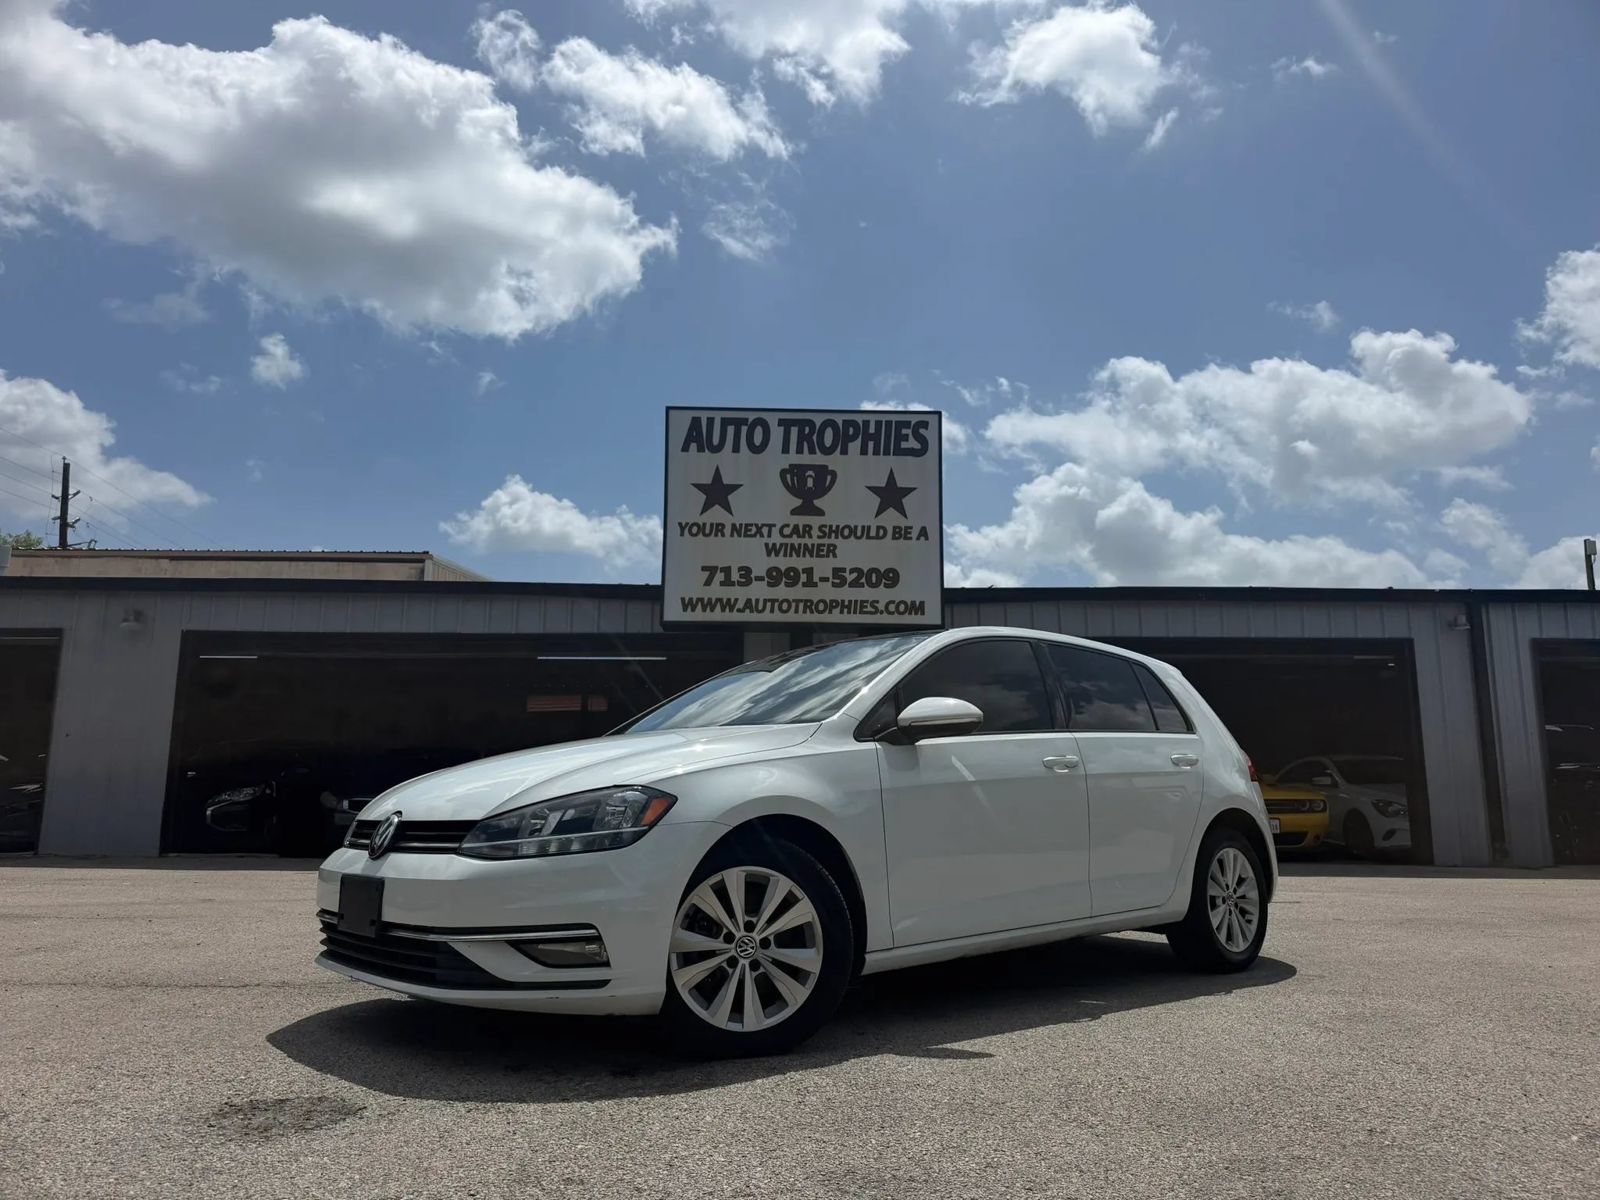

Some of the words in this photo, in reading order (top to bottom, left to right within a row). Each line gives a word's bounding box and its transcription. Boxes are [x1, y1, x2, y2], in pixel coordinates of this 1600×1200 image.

[680, 416, 771, 454] AUTO
[777, 418, 930, 458] TROPHIES
[677, 522, 726, 538] YOUR
[730, 523, 776, 538] NEXT
[779, 523, 814, 539] CAR
[817, 524, 888, 541] SHOULD
[891, 525, 913, 541] BE
[916, 526, 929, 541] A
[764, 542, 838, 558] WINNER
[701, 565, 900, 589] 713-991-5209
[680, 597, 926, 616] WWW.AUTOTROPHIES.COM
